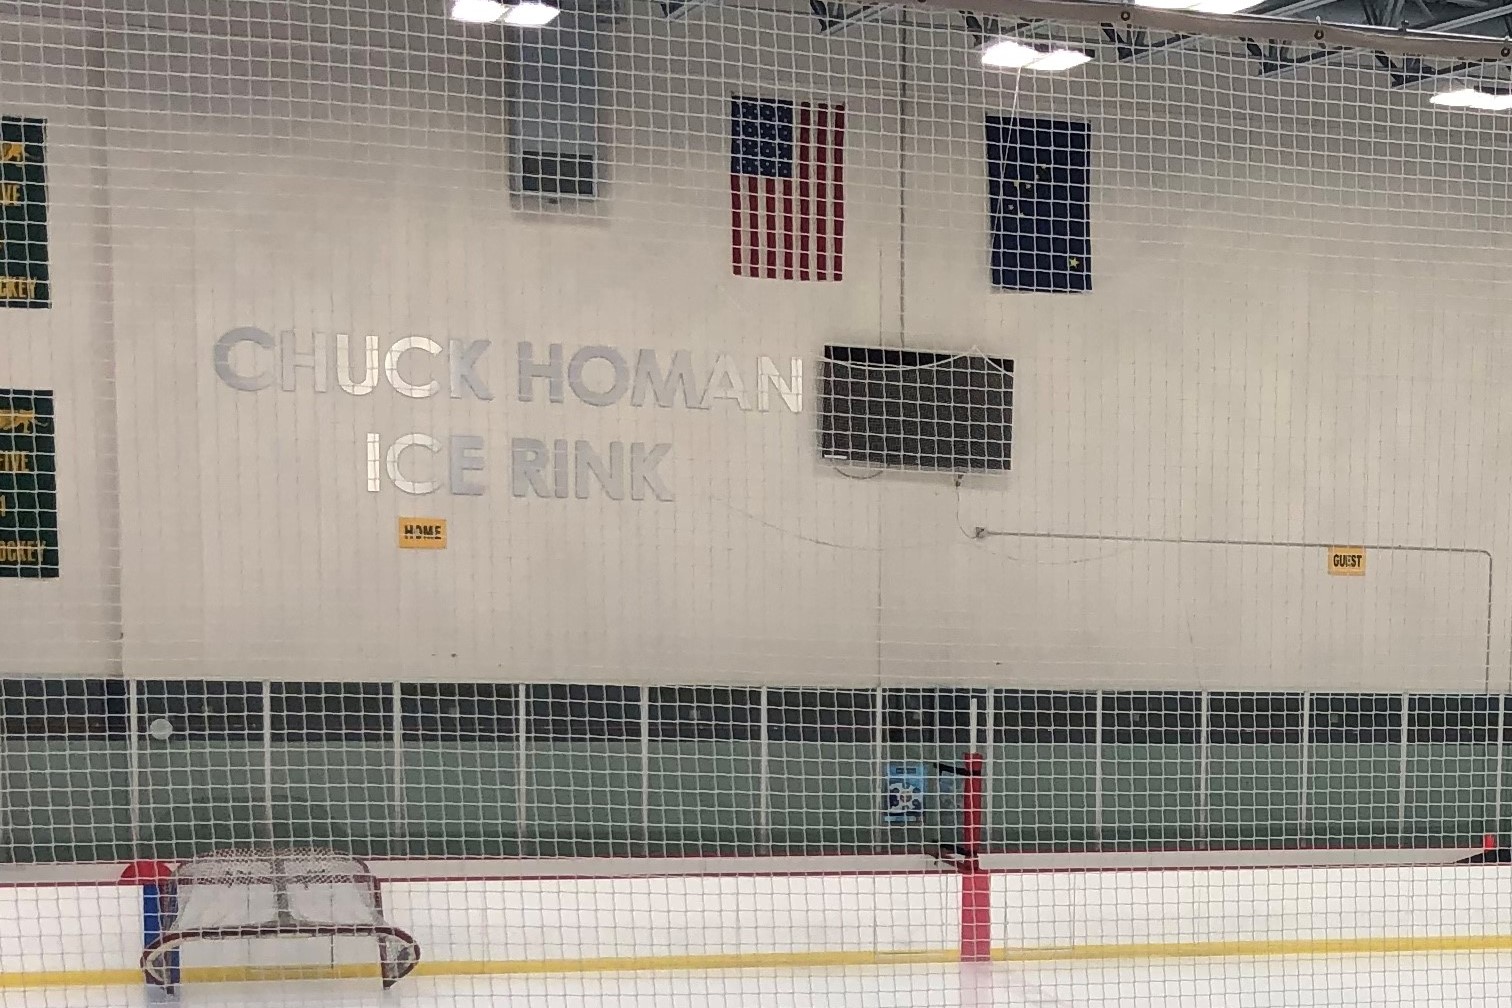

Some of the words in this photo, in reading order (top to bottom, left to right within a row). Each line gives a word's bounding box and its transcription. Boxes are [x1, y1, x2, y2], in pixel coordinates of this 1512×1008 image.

[214, 326, 493, 401] CHUCK
[517, 341, 803, 413] HOMAN
[366, 433, 486, 496] ICE
[511, 436, 675, 502] RINK
[404, 524, 442, 540] HOME
[1333, 553, 1362, 567] GUEST
